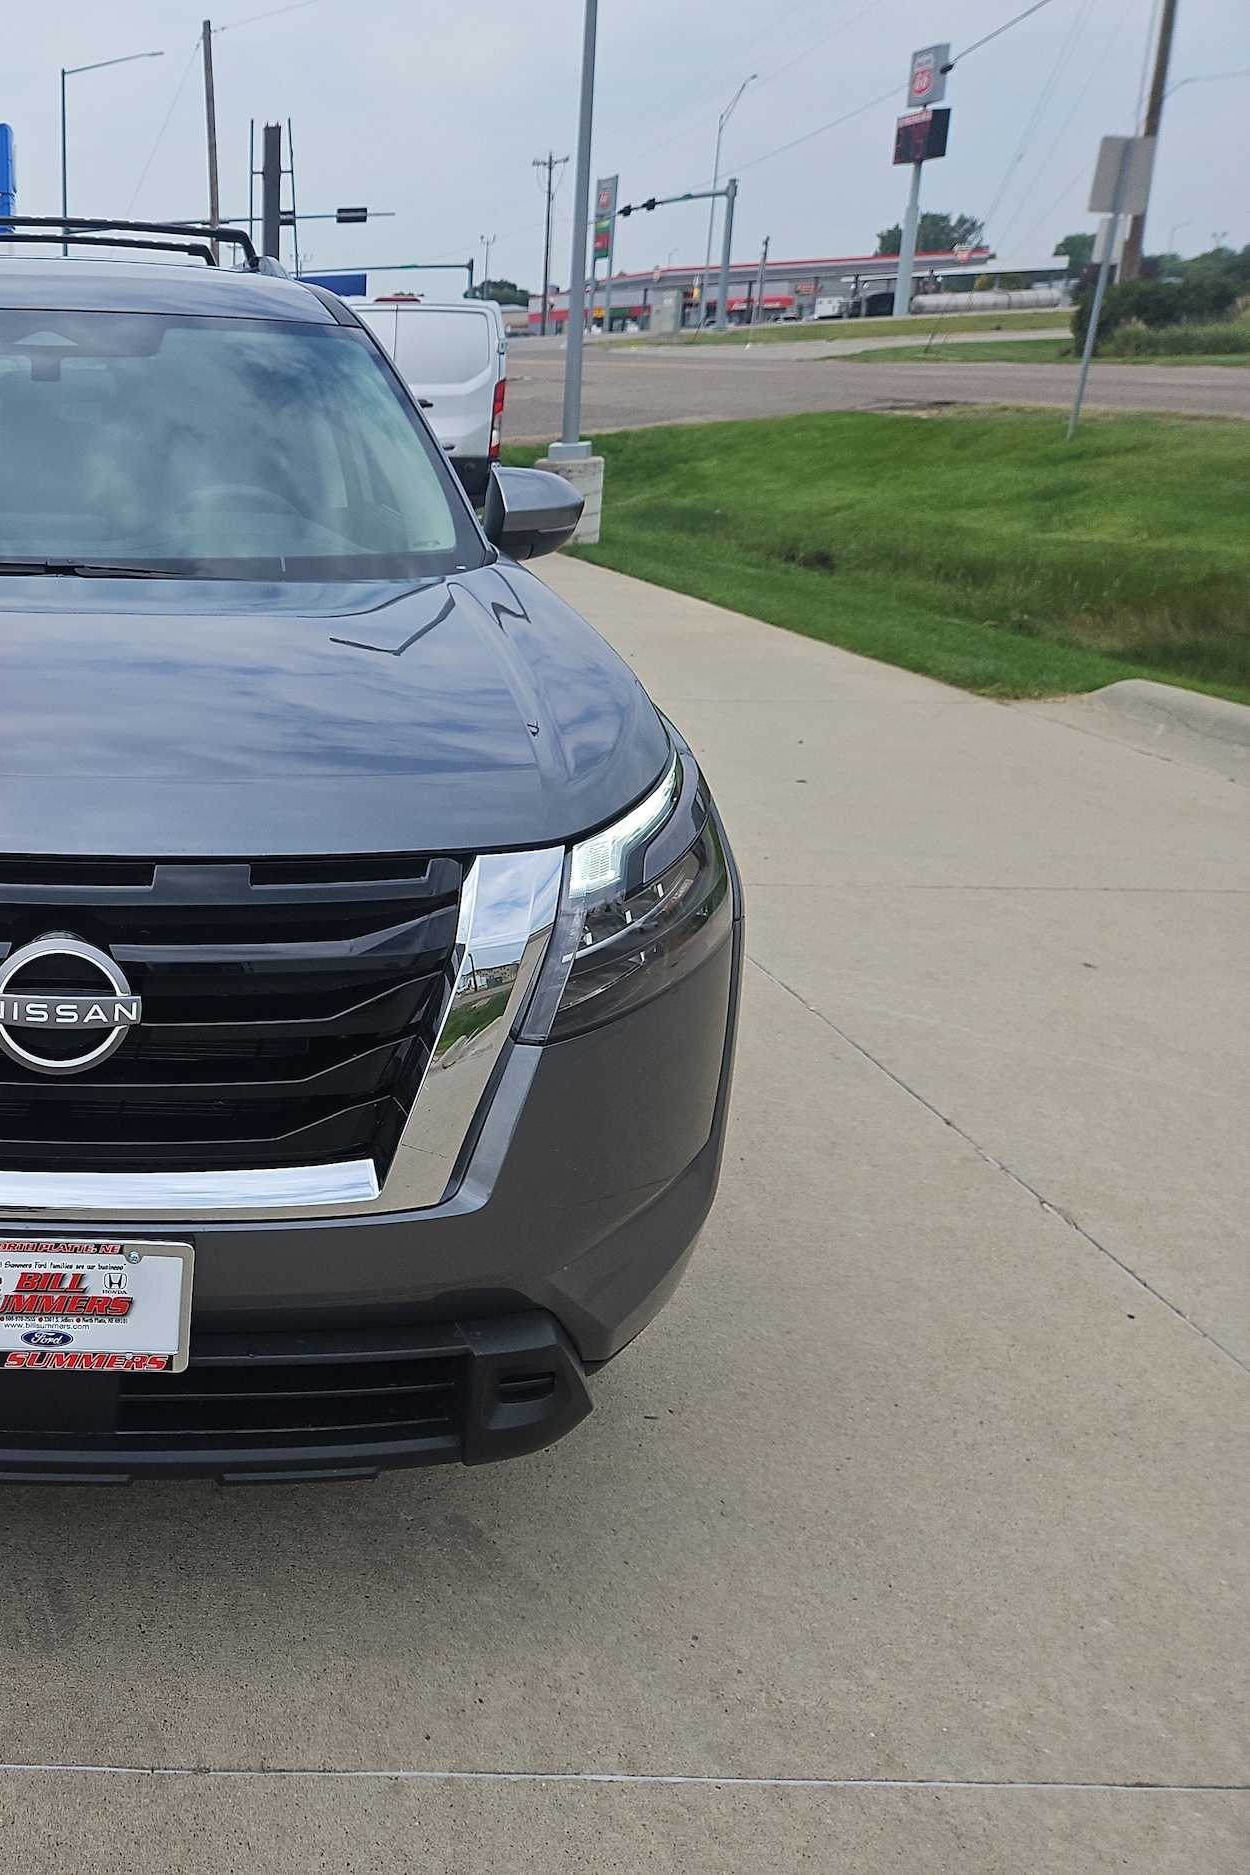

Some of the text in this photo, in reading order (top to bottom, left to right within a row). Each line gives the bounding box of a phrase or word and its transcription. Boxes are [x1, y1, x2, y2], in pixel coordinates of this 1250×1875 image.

[37, 1243, 97, 1254] PLATTE,
[99, 1244, 121, 1254] NE
[4, 1260, 32, 1269] Summers
[34, 1261, 47, 1269] Ford
[50, 1261, 74, 1270] families
[14, 1271, 87, 1292] BILL
[4, 1322, 90, 1330] www.billsummers.com
[31, 1332, 63, 1344] Ford
[4, 1351, 169, 1371] SUMMERS
